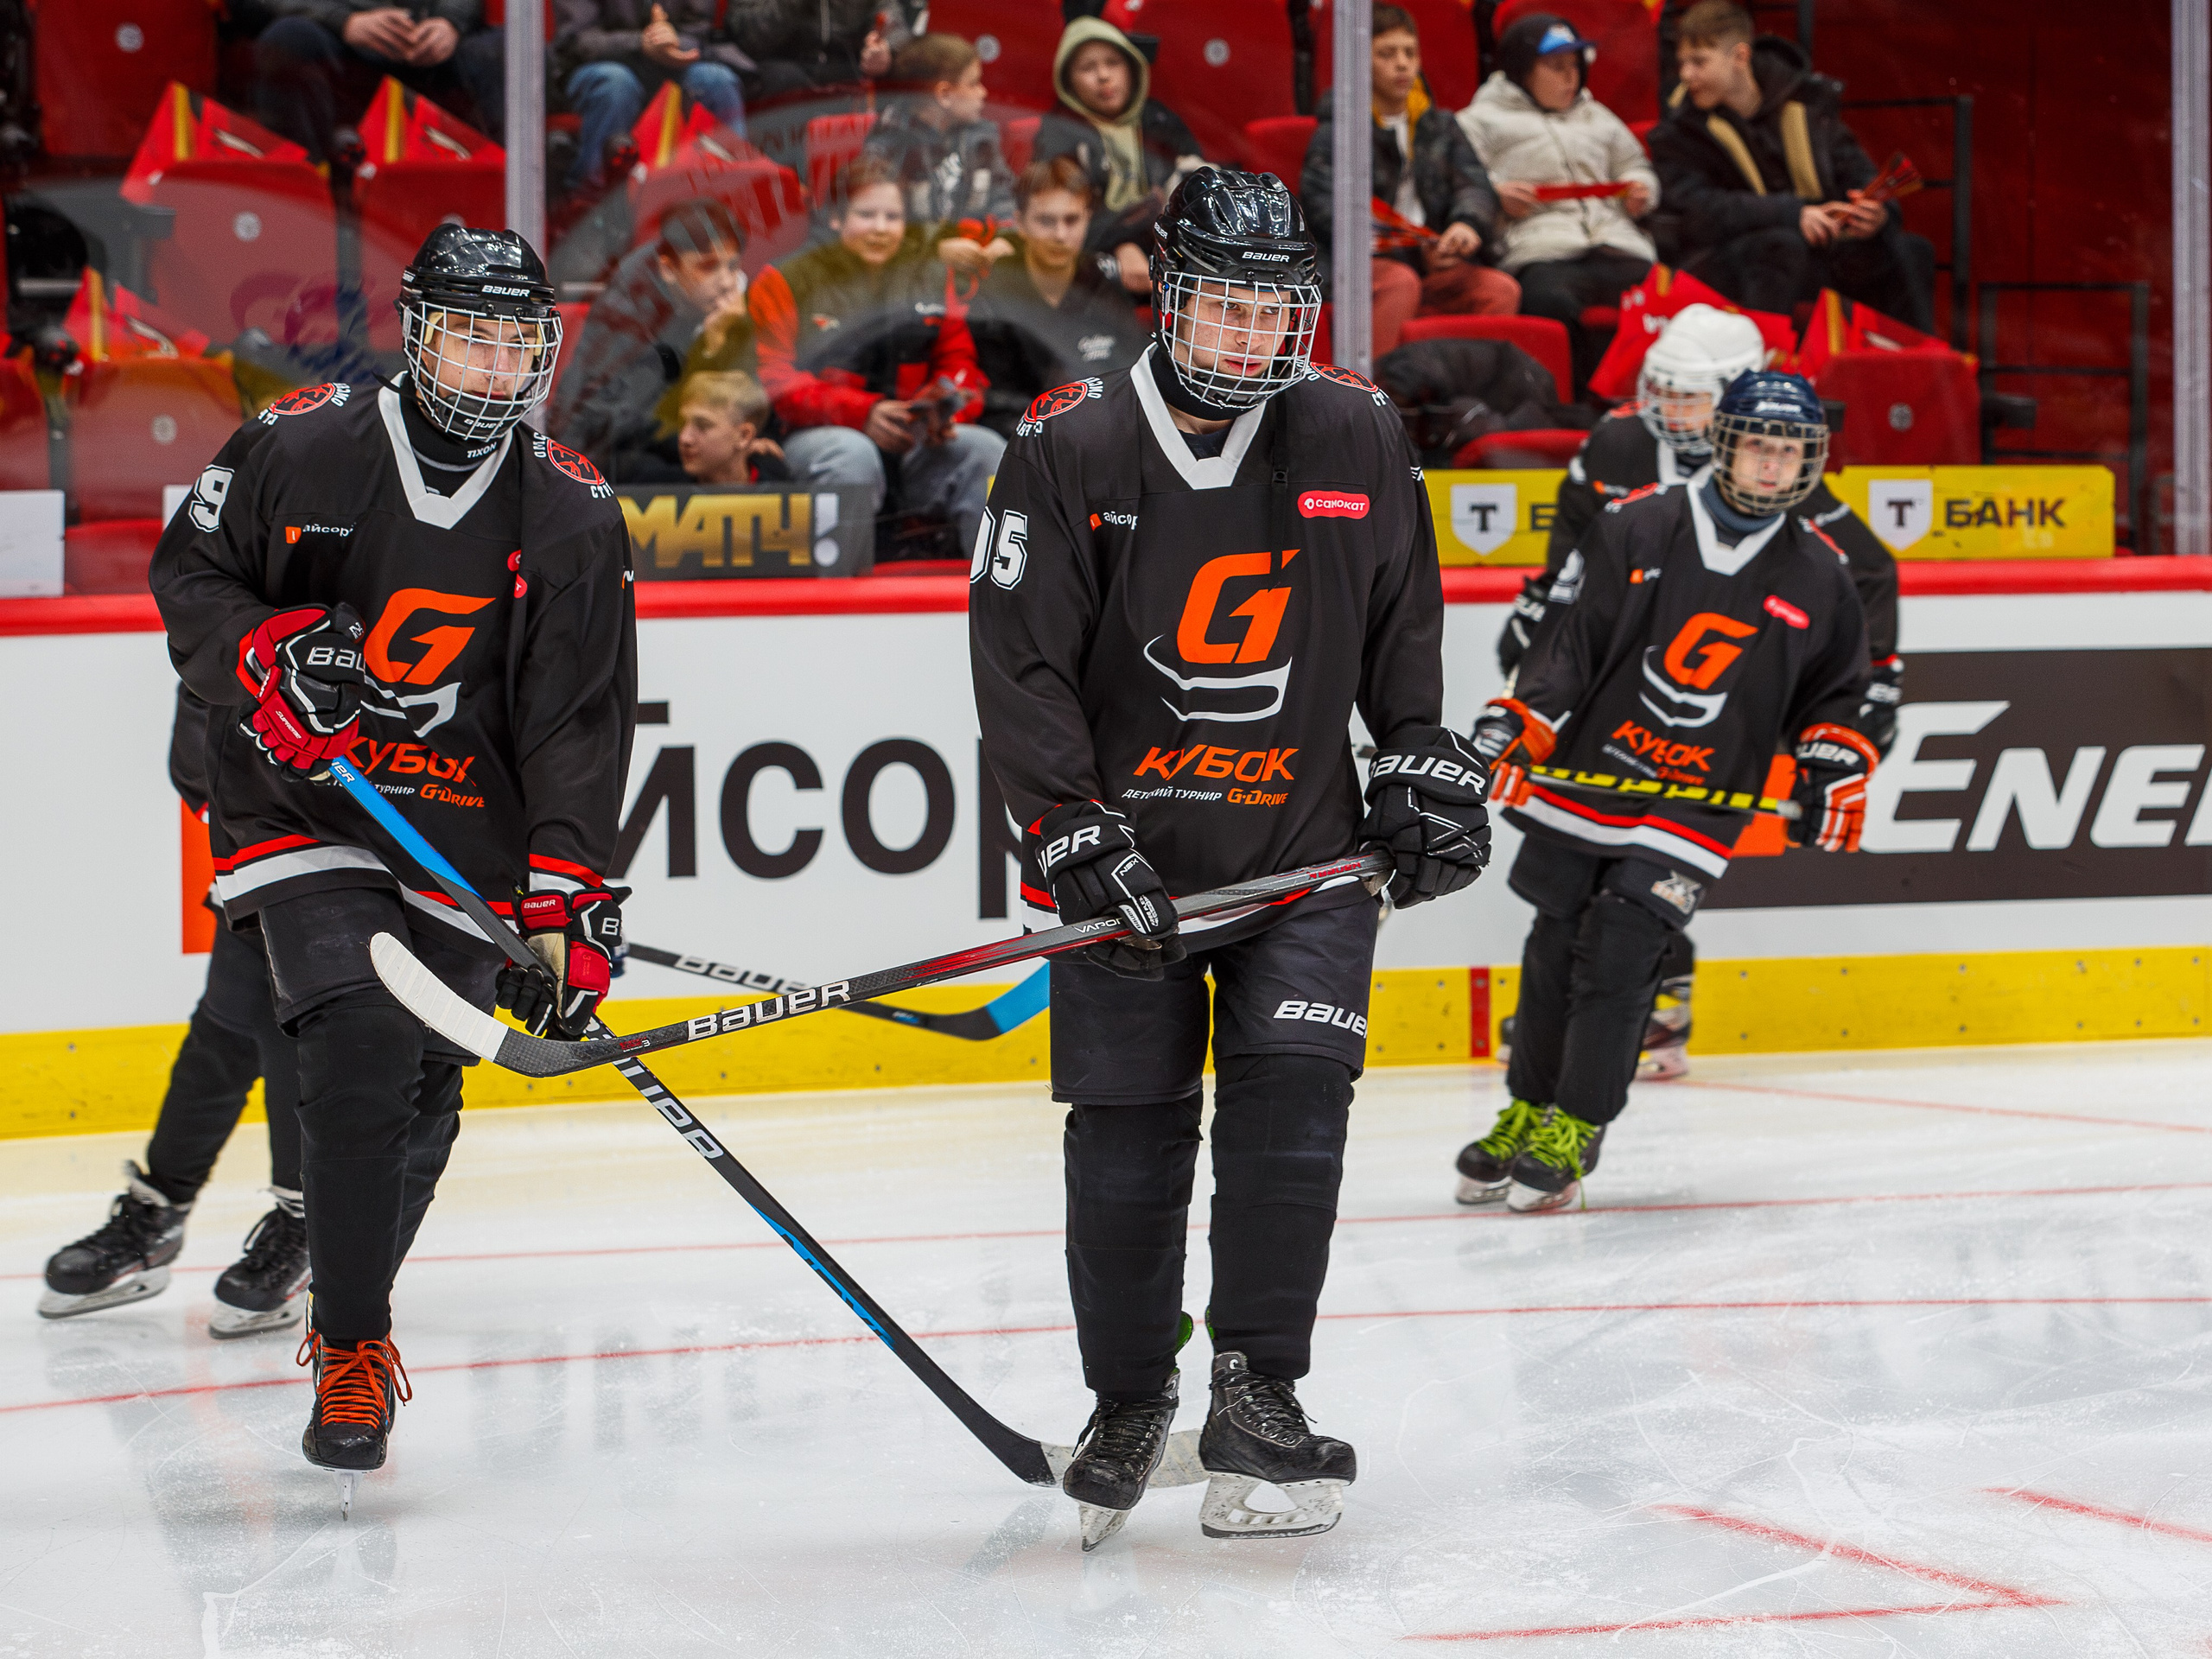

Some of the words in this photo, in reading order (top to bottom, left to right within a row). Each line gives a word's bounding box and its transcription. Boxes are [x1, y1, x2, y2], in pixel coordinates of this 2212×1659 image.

[1242, 251, 1290, 263] BAUER
[481, 284, 531, 297] BAUER
[467, 442, 498, 459] TIXON
[188, 464, 235, 533] 9
[1945, 498, 2066, 529] БАНК
[1133, 744, 1300, 783] КУБОК
[1859, 700, 2212, 854] ENE
[1175, 788, 1224, 802] ТУРНИР
[524, 899, 556, 909] BAUER
[688, 980, 851, 1042] BAUER
[1273, 1000, 1367, 1039] BAUE
